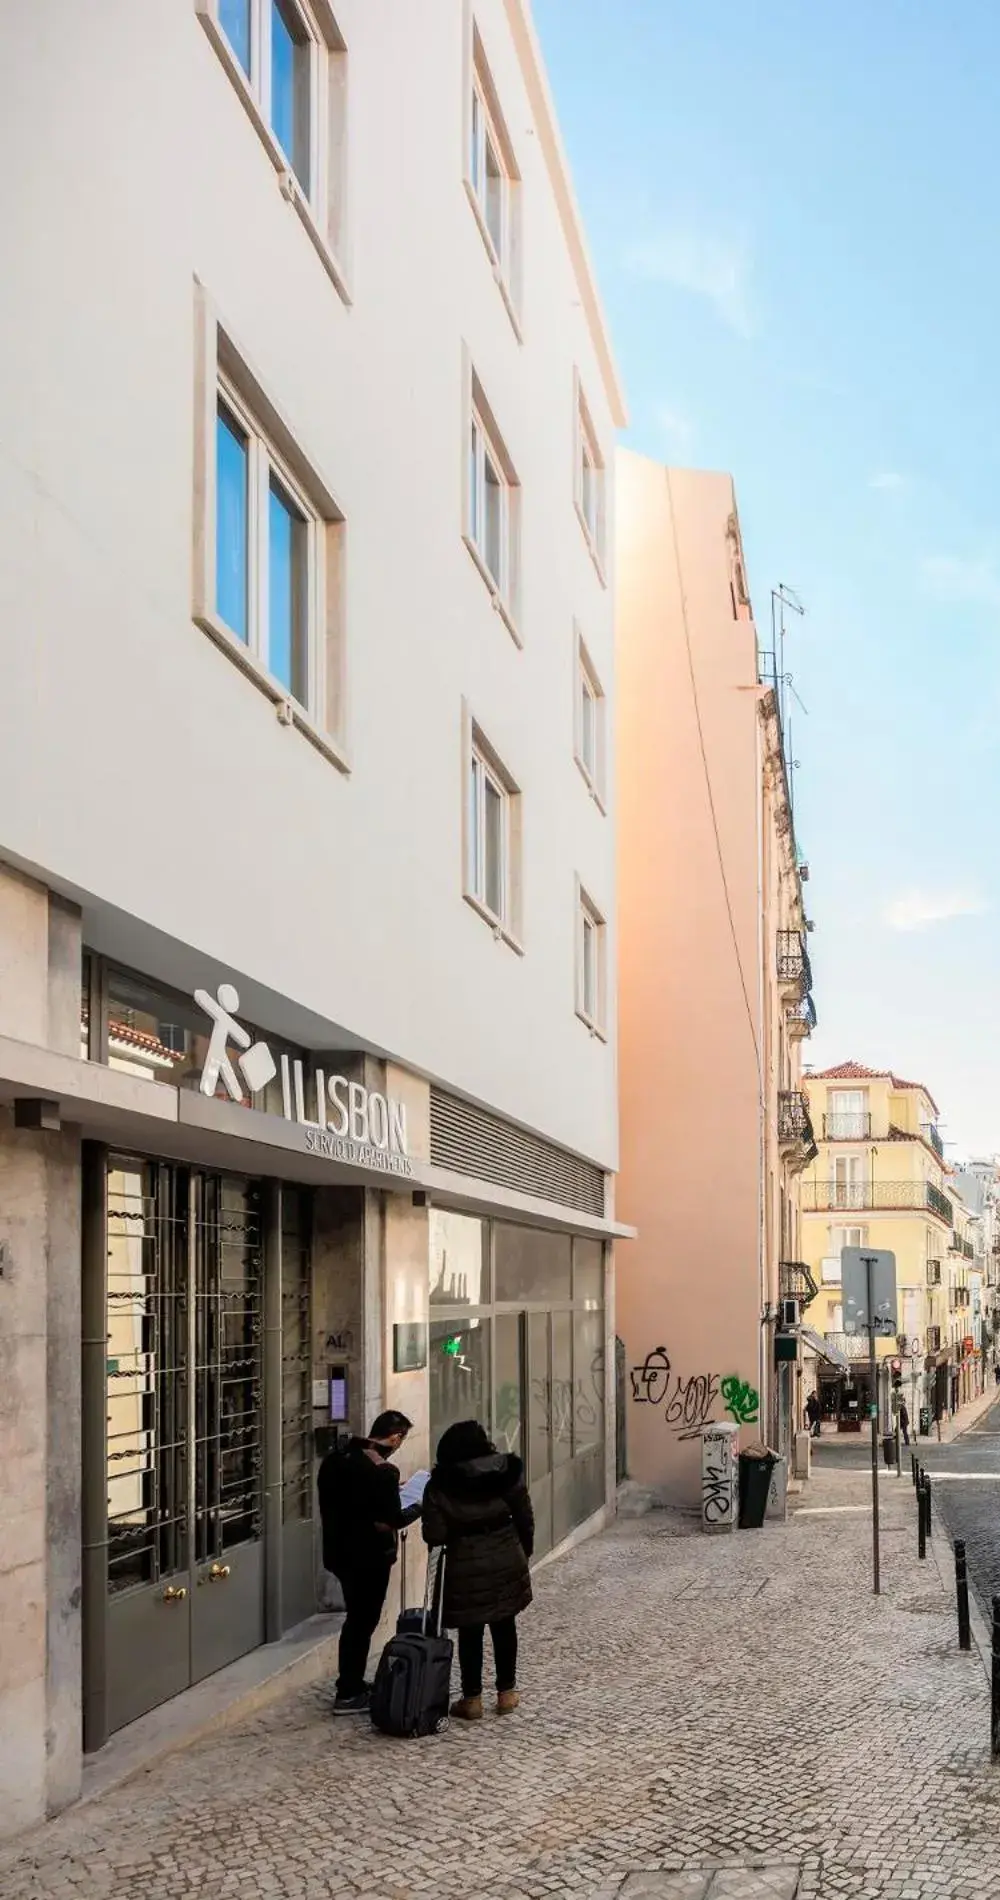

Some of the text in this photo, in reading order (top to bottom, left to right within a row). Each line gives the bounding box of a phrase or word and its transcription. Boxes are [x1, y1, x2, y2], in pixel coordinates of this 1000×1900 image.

[280, 1054, 408, 1155] ILISBON
[305, 1130, 413, 1176] SERVICED APARTMENTS
